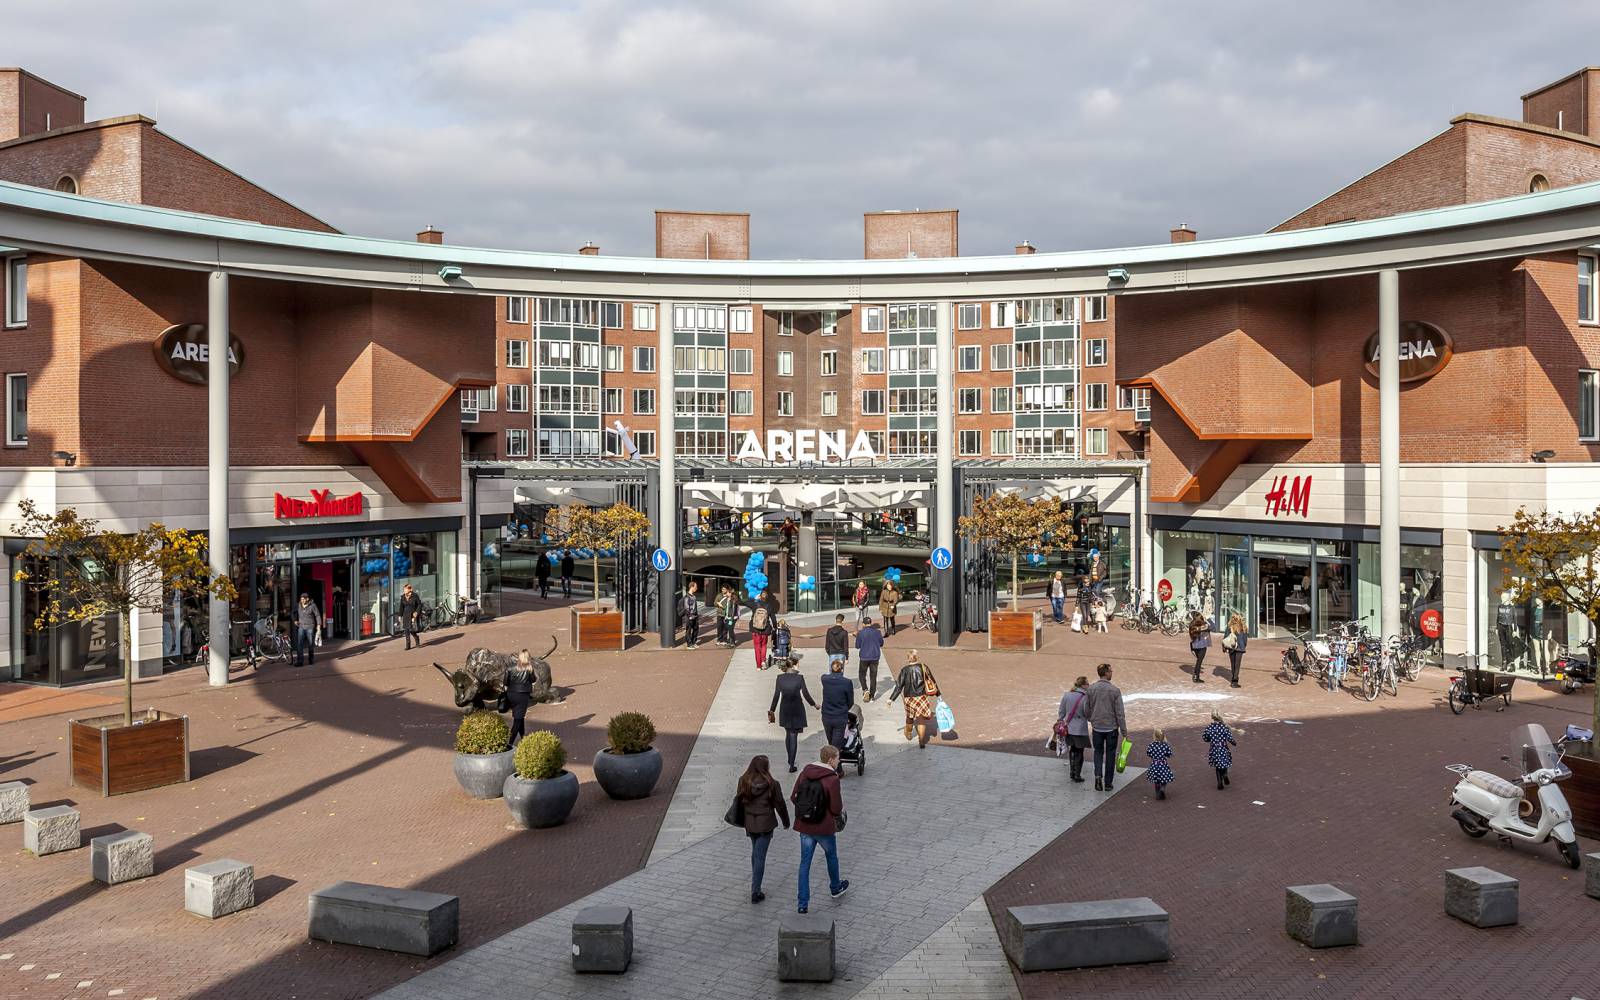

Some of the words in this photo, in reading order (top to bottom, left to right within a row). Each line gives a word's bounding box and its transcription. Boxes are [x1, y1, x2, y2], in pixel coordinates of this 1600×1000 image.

[171, 341, 238, 364] AREA
[1371, 339, 1437, 362] AENA
[736, 429, 876, 461] ARENA
[1264, 475, 1312, 518] H&M
